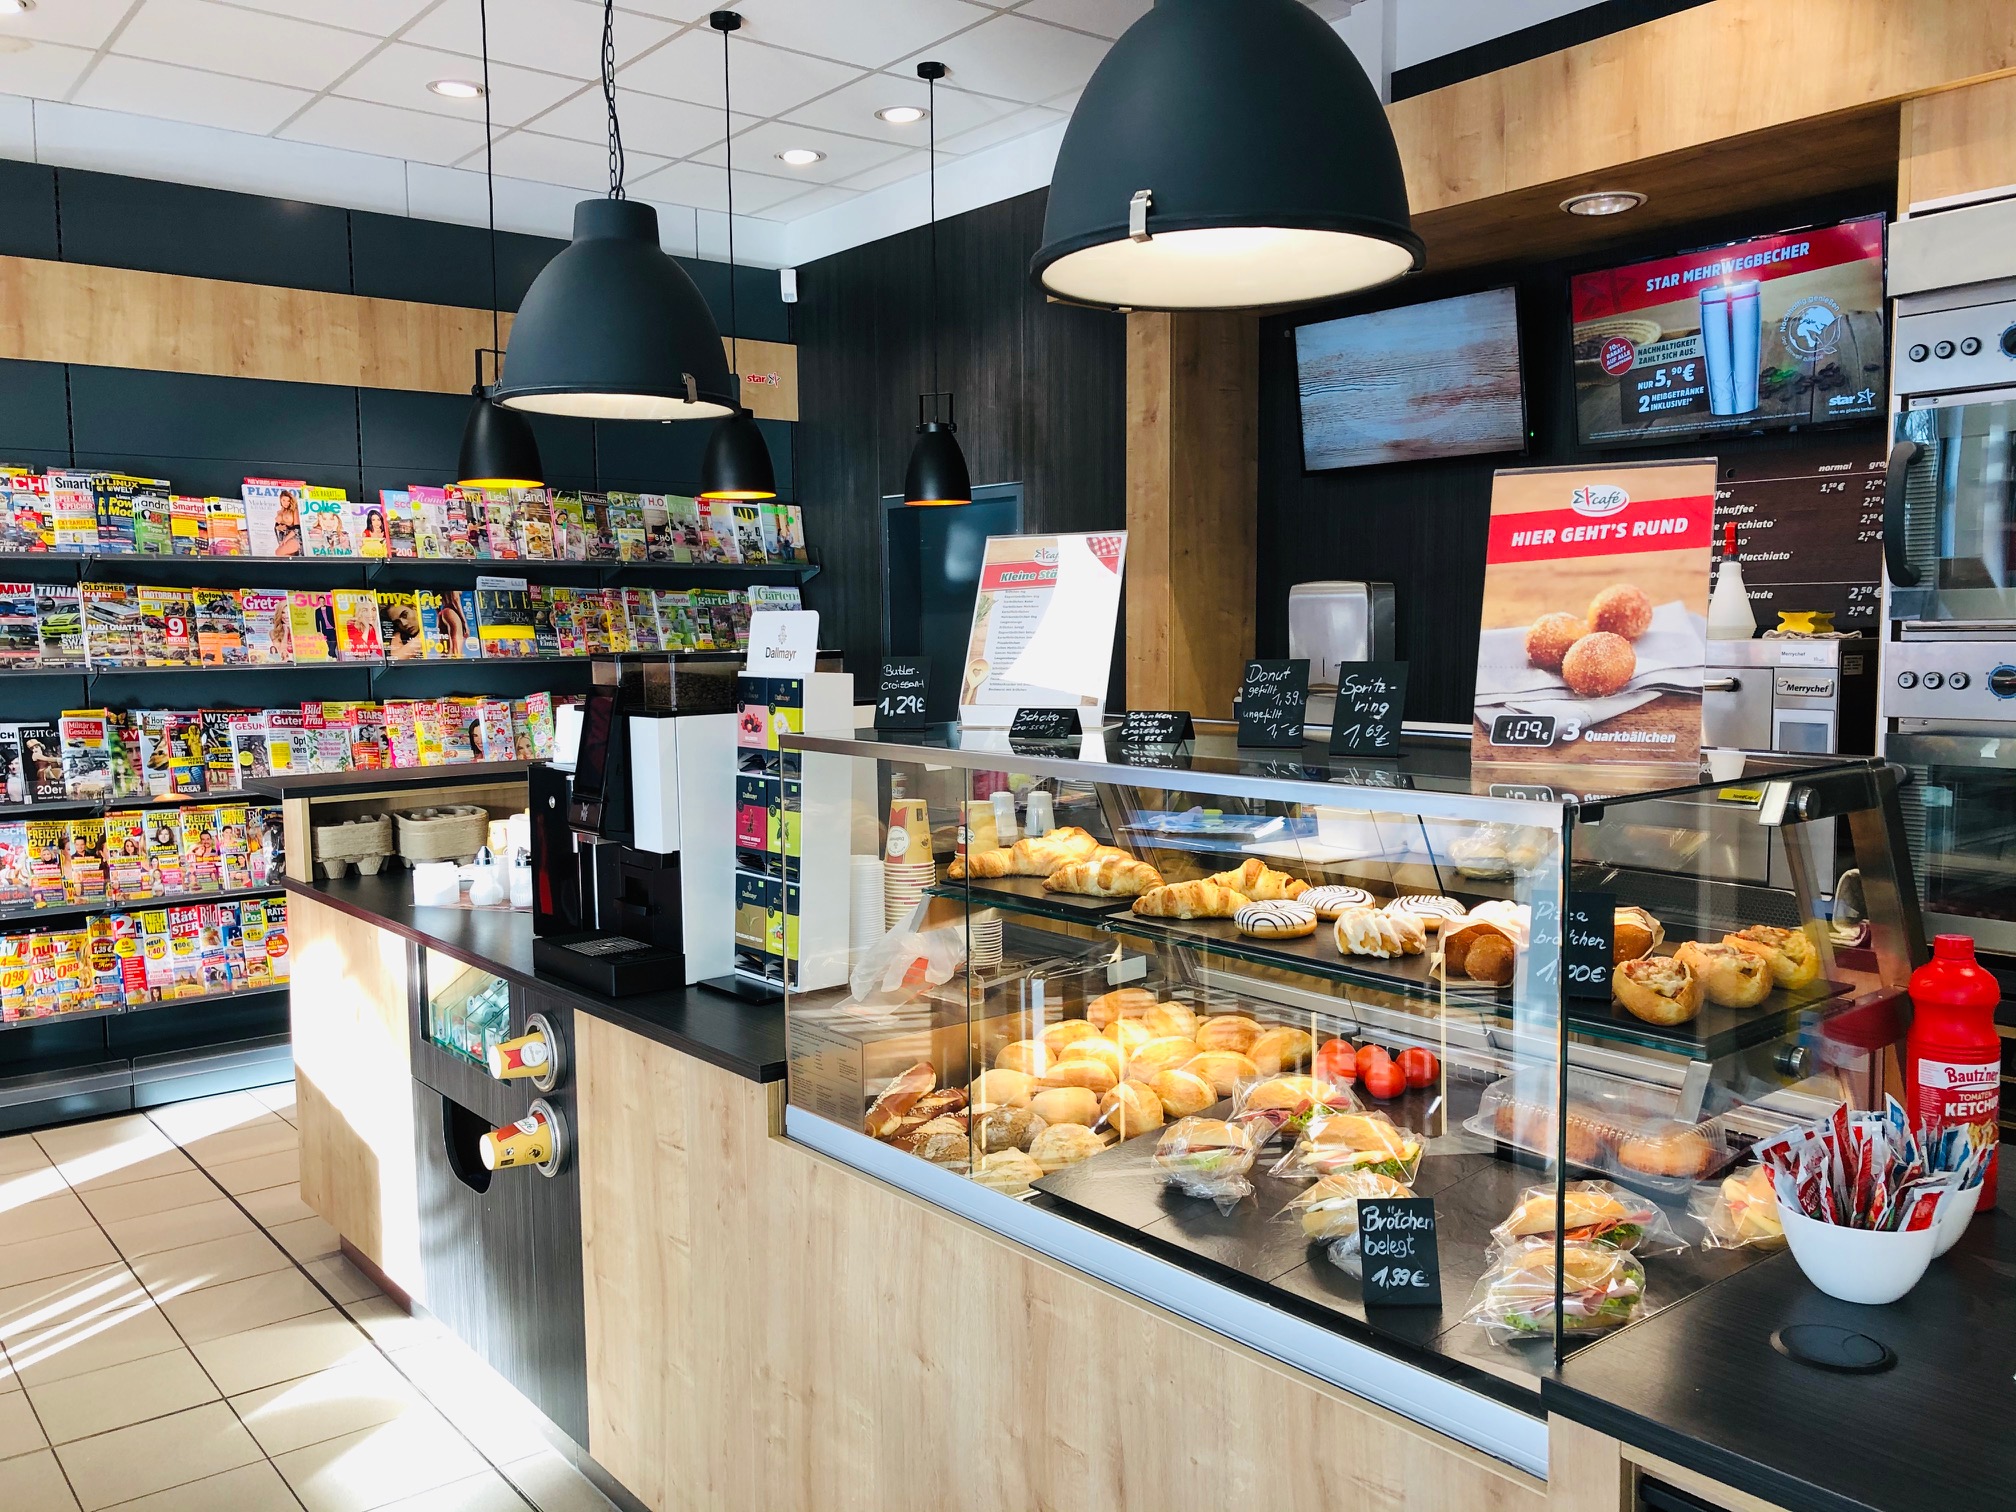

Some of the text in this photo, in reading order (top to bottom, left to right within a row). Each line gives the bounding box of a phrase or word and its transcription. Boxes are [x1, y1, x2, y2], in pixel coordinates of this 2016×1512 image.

[1647, 242, 1809, 292] STAR MEHRWEGBECHER
[1808, 296, 1840, 312] genießen
[1638, 338, 1697, 356] NACHHALTIGKEIT
[1606, 357, 1617, 367] AUF
[1618, 350, 1631, 361] ALLE
[1638, 354, 1660, 365] ZAHLT
[1662, 350, 1678, 360] SICH
[1679, 347, 1696, 357] AUS:
[747, 374, 767, 383] star
[1638, 380, 1654, 391] NUR
[1655, 363, 1696, 389] 5,90€
[1638, 395, 1650, 413] 2
[1828, 394, 1856, 406] star
[1819, 462, 1852, 472] normal
[106, 480, 139, 488] LINUX
[1820, 482, 1846, 494] 1,50€
[1592, 491, 1622, 509] café
[1714, 504, 1757, 516] chkaffee
[1511, 517, 1689, 547] HIER GEHT'S RUND
[1858, 531, 1884, 542] 2,50€
[396, 548, 412, 556] 200
[1001, 570, 1059, 583] Kleine Stä
[0, 584, 32, 594] MW
[82, 584, 125, 592] OLDTIMER
[1848, 586, 1882, 601] 2,50€
[84, 591, 112, 599] MARKT
[143, 591, 180, 600] MOTORRAD
[478, 591, 531, 609] ELLE
[1848, 606, 1874, 617] 2,00€
[86, 624, 108, 632] AUDI
[168, 617, 184, 637] 9
[426, 639, 449, 653] Po!
[766, 647, 796, 661] Dallmayr
[1246, 664, 1291, 683] Donut
[1248, 684, 1278, 698] gefüllt
[1786, 684, 1829, 694] Merrychef
[305, 704, 322, 714] Bild
[419, 703, 433, 711] Frau
[443, 704, 460, 713] Frau
[528, 704, 545, 714] Frau
[879, 695, 926, 717] 1,29€
[272, 716, 303, 725] Guter
[305, 715, 323, 725] Frau
[357, 711, 383, 720] STARS
[387, 716, 404, 724] Frau
[1243, 708, 1283, 724] ungefüllt
[69, 728, 102, 736] Geschichte
[1505, 718, 1676, 744] 1,09€ 3 Quarkbällchen
[37, 785, 63, 795] 20er
[147, 812, 180, 820] FREIZEIT
[184, 814, 215, 822] FREIZEIT
[107, 820, 141, 830] FREIZEIT
[28, 829, 62, 839] FREIZEIT
[70, 826, 104, 836] FREIZEIT
[200, 906, 218, 924] Bild
[1944, 1066, 1998, 1083] Bautz'ner
[1958, 1091, 1993, 1101] TOMATEN
[1362, 1205, 1434, 1232] Brötchen
[1364, 1232, 1415, 1258] belegt
